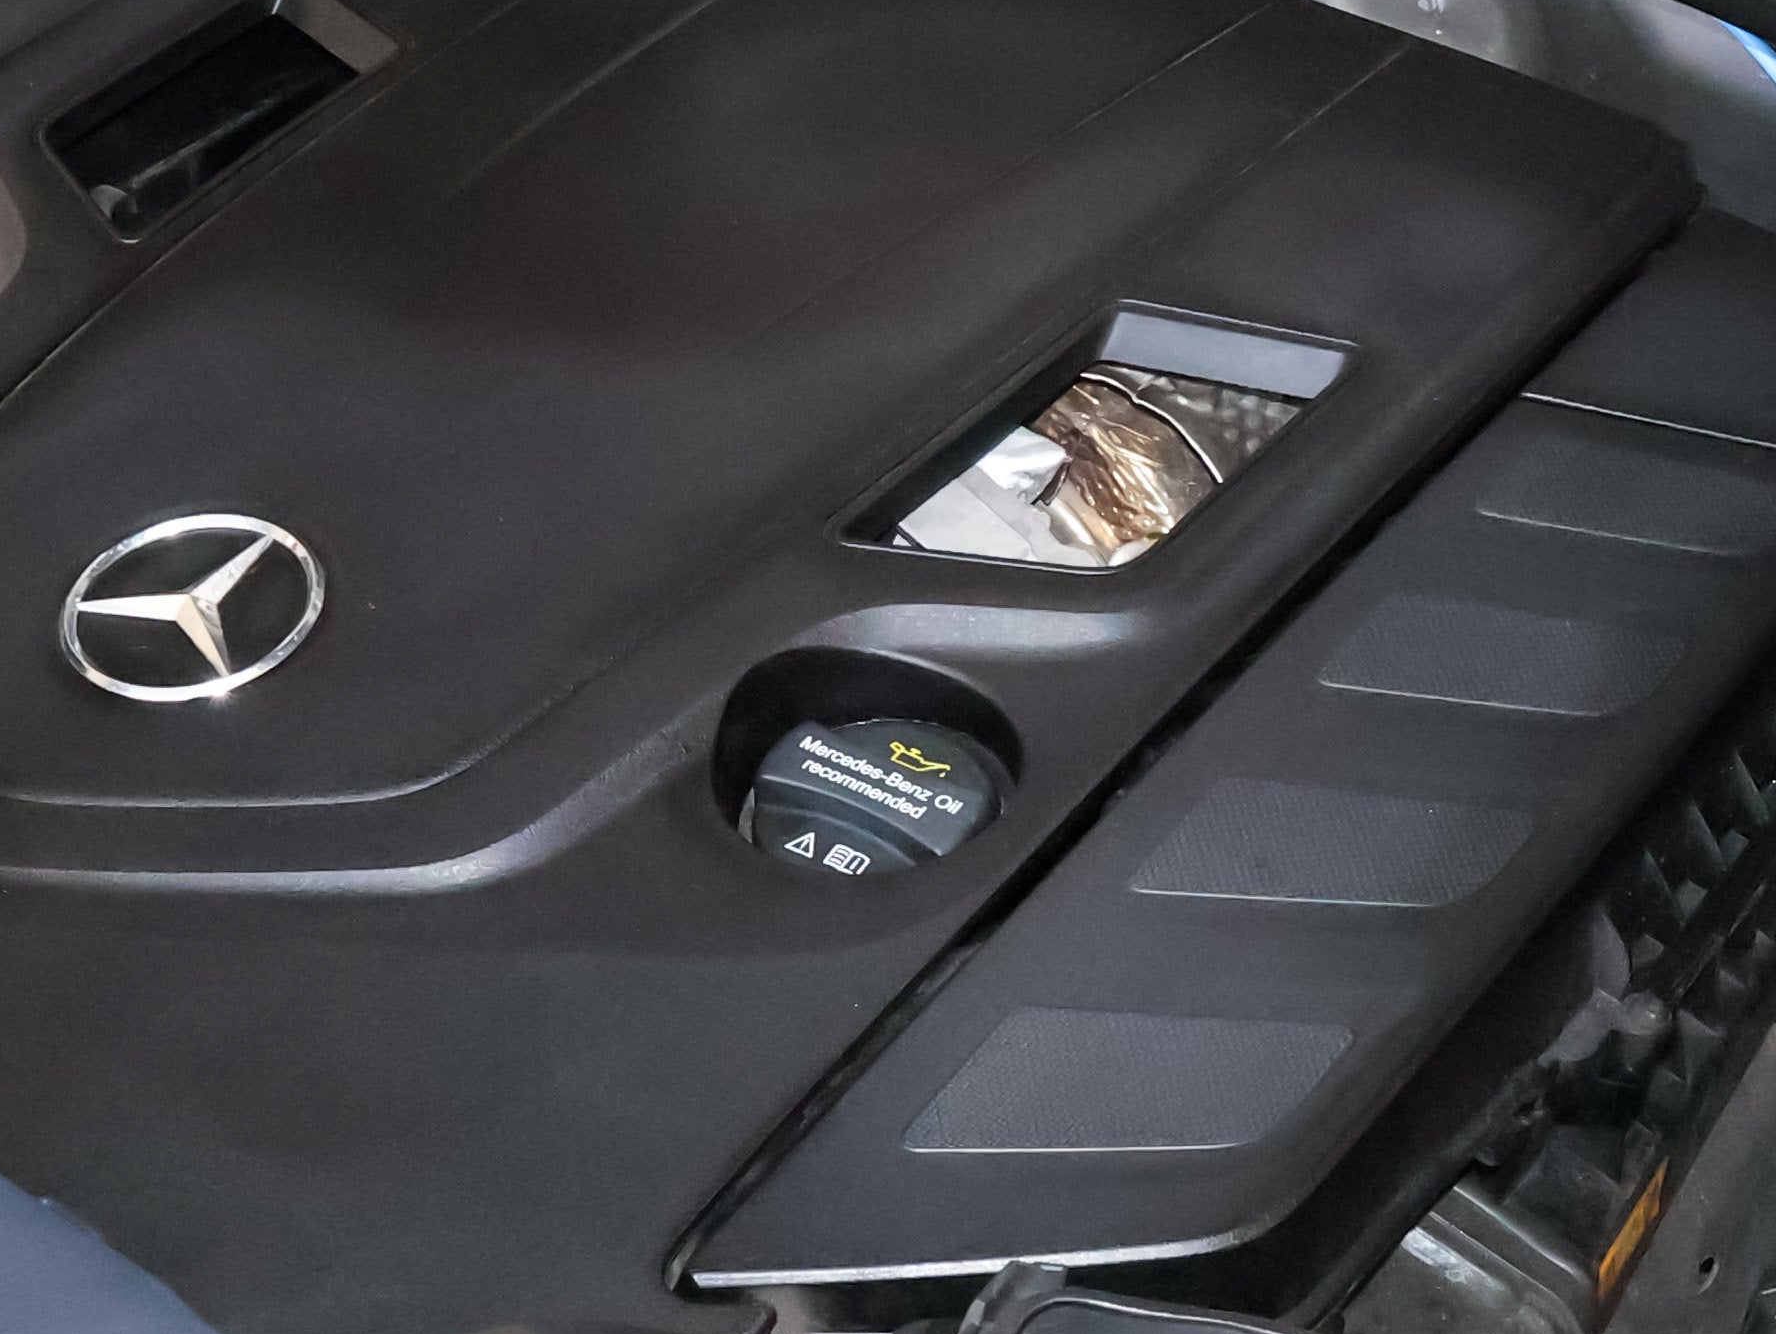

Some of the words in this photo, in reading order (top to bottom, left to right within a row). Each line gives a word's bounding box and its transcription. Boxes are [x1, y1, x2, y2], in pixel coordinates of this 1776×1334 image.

[799, 735, 931, 802] Mercedes-Benz
[934, 793, 964, 815] Oil
[801, 757, 927, 821] recommended
